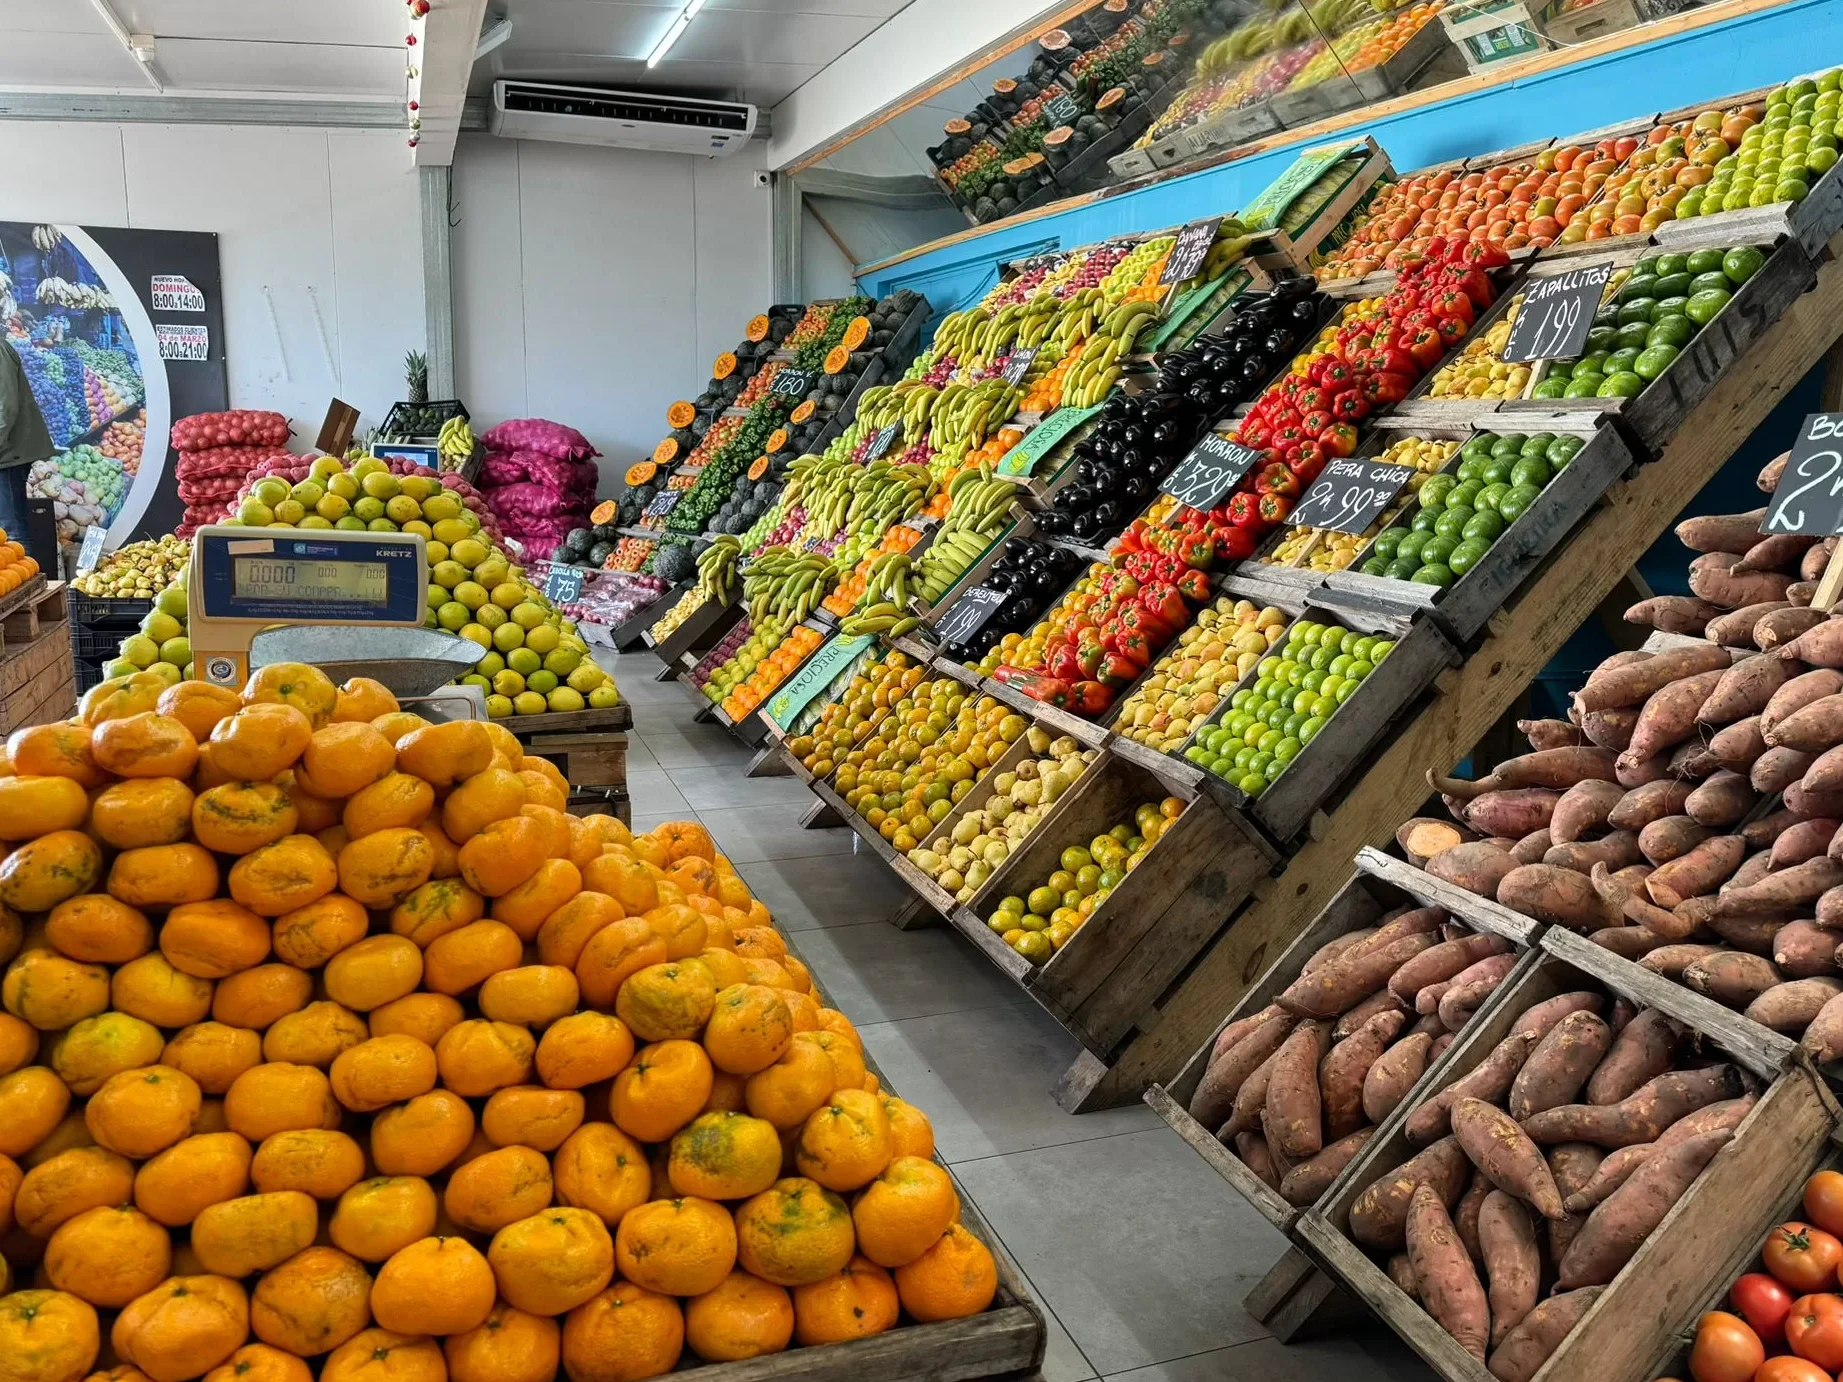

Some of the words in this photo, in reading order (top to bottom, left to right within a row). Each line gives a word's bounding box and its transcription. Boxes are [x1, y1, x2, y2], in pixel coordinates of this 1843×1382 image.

[1523, 266, 1611, 305] ZAPALLITOS
[153, 293, 174, 308] 8:00
[178, 294, 203, 310] 14:00
[1524, 295, 1582, 361] 199
[159, 341, 180, 358] 8:00
[773, 374, 804, 396] 180
[1199, 434, 1256, 466] MORRON
[1327, 459, 1364, 479] PERA
[1369, 465, 1411, 484] CHICA
[375, 550, 413, 558] KRETZ
[554, 576, 576, 602] 75
[939, 604, 982, 641] 199
[791, 645, 840, 695] PRECIOSA
